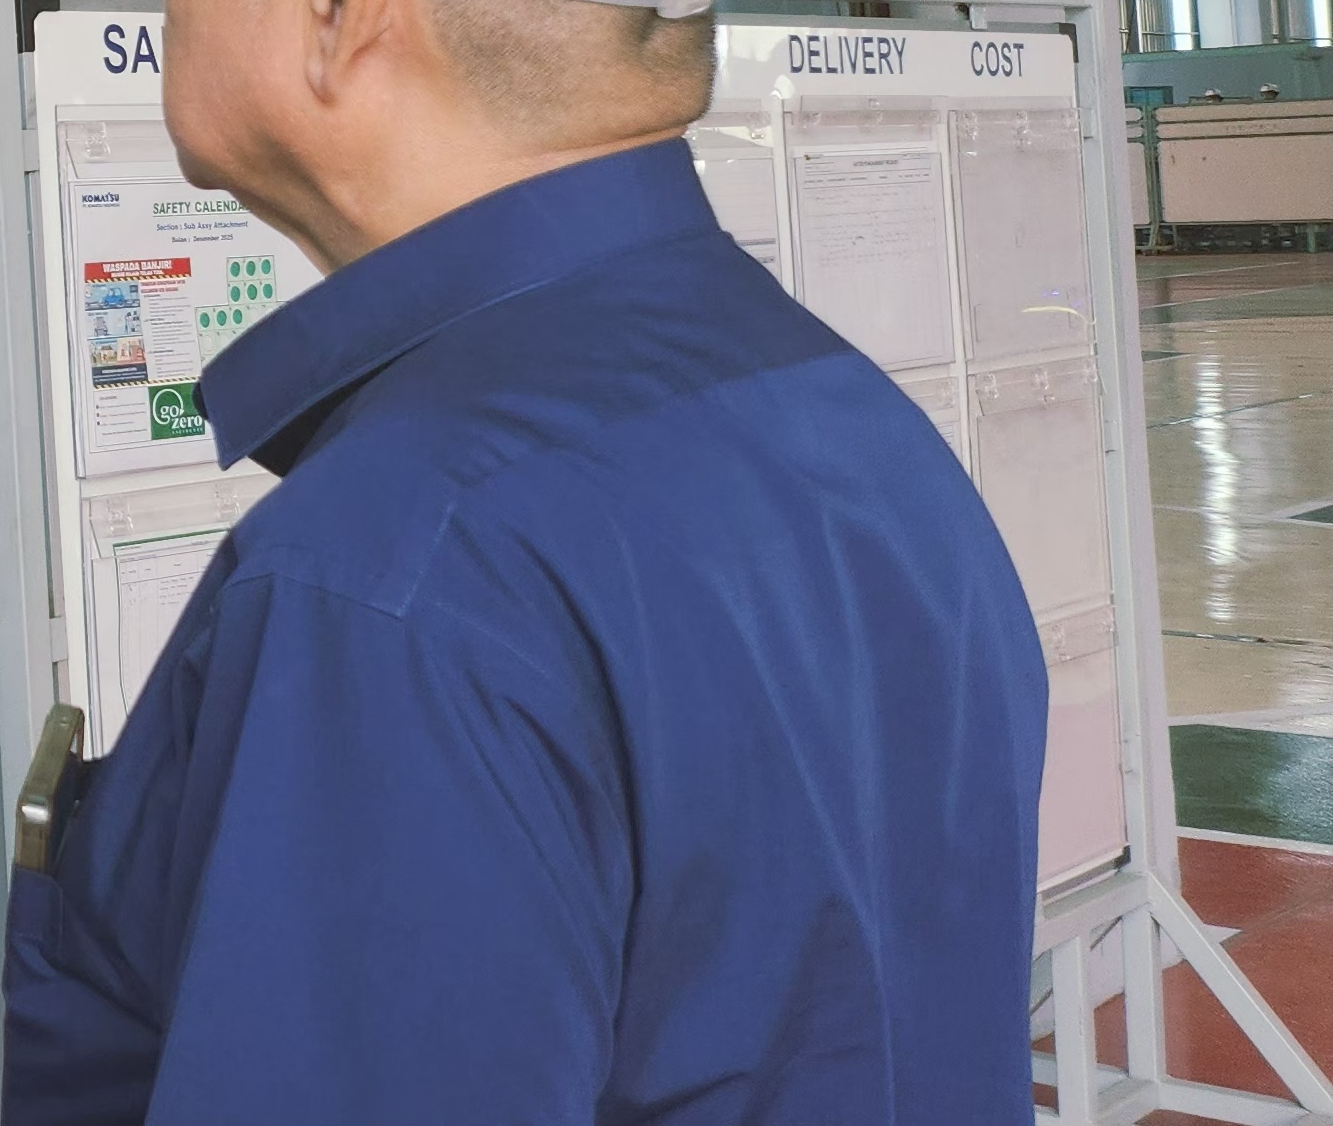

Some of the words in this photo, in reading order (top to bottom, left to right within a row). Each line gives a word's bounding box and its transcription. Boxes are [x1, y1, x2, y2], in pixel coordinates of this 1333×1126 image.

[788, 35, 907, 77] DELIVERY
[970, 41, 1025, 78] COST
[82, 192, 120, 202] KOMATSU
[153, 202, 191, 214] SAFETY
[195, 200, 249, 212] CALENDA
[198, 222, 212, 230] Assy
[103, 262, 140, 272] WASPADA
[171, 415, 203, 429] zero
